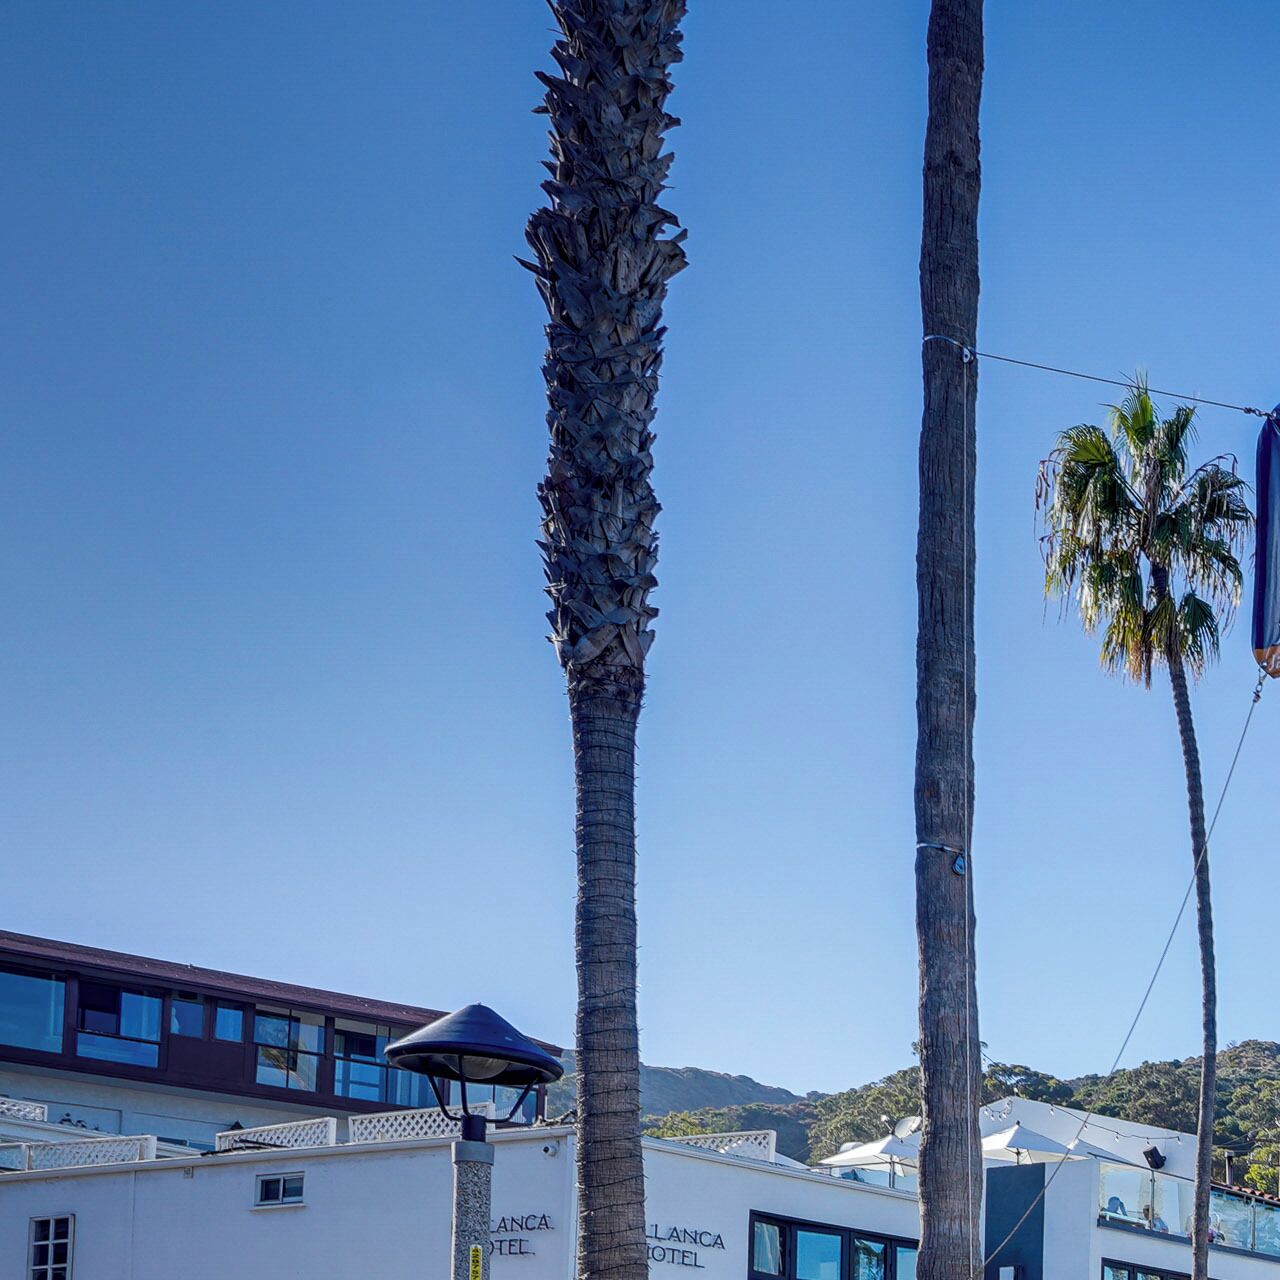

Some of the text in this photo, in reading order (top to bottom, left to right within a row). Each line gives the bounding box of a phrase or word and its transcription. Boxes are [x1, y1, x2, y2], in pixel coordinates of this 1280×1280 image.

[490, 1213, 553, 1233] ANCA
[646, 1224, 725, 1249] LANCA
[647, 1245, 705, 1268] OTEL
